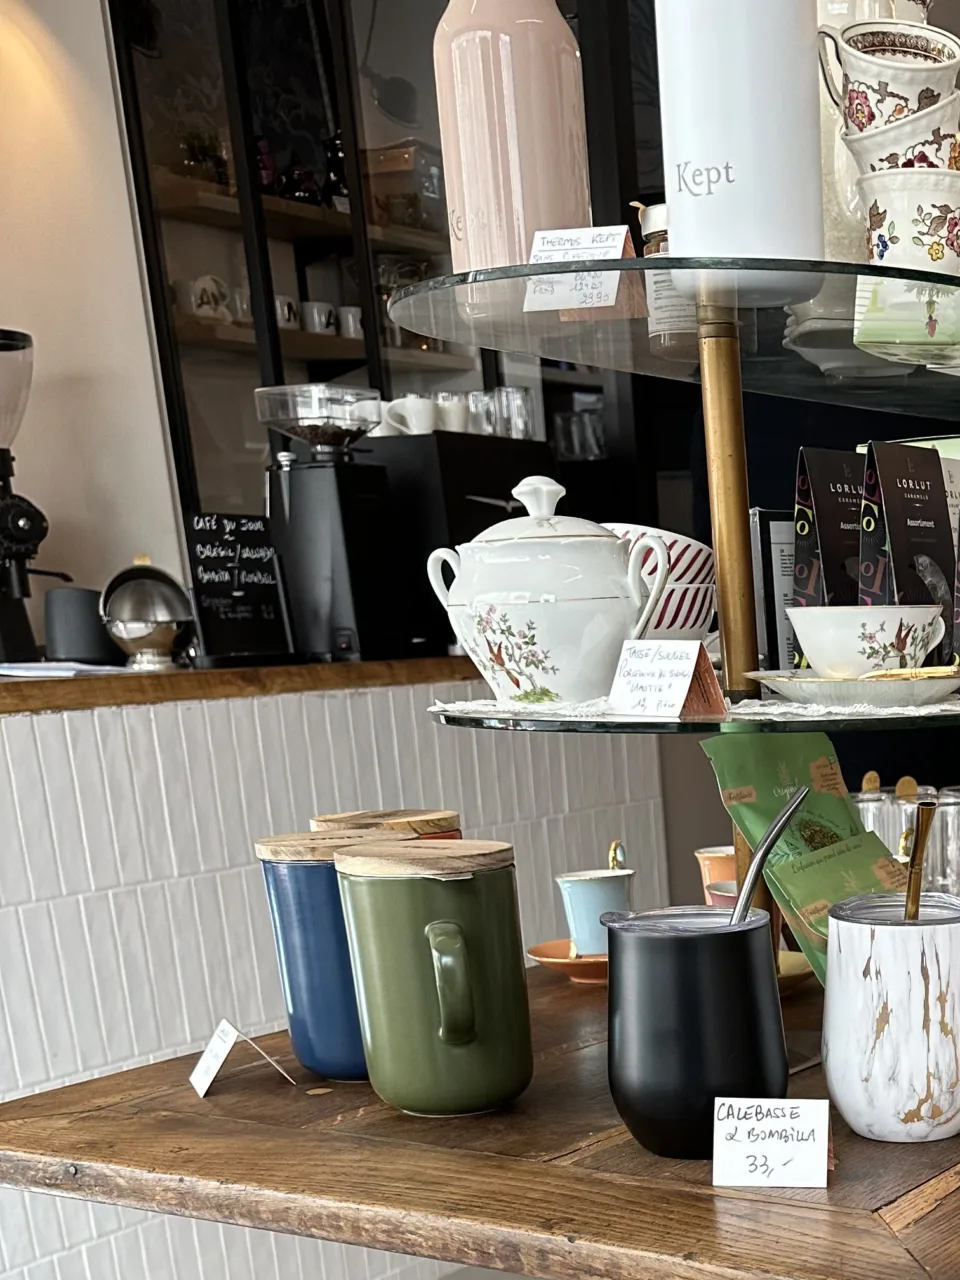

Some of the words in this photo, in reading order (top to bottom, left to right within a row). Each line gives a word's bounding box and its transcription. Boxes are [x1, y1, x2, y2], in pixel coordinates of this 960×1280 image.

[676, 161, 736, 197] Kept
[830, 483, 863, 494] LORLU
[896, 478, 931, 491] LORLUT
[222, 519, 236, 533] DU
[906, 518, 936, 528] Assortiment
[717, 1103, 801, 1121] CALEBASSE
